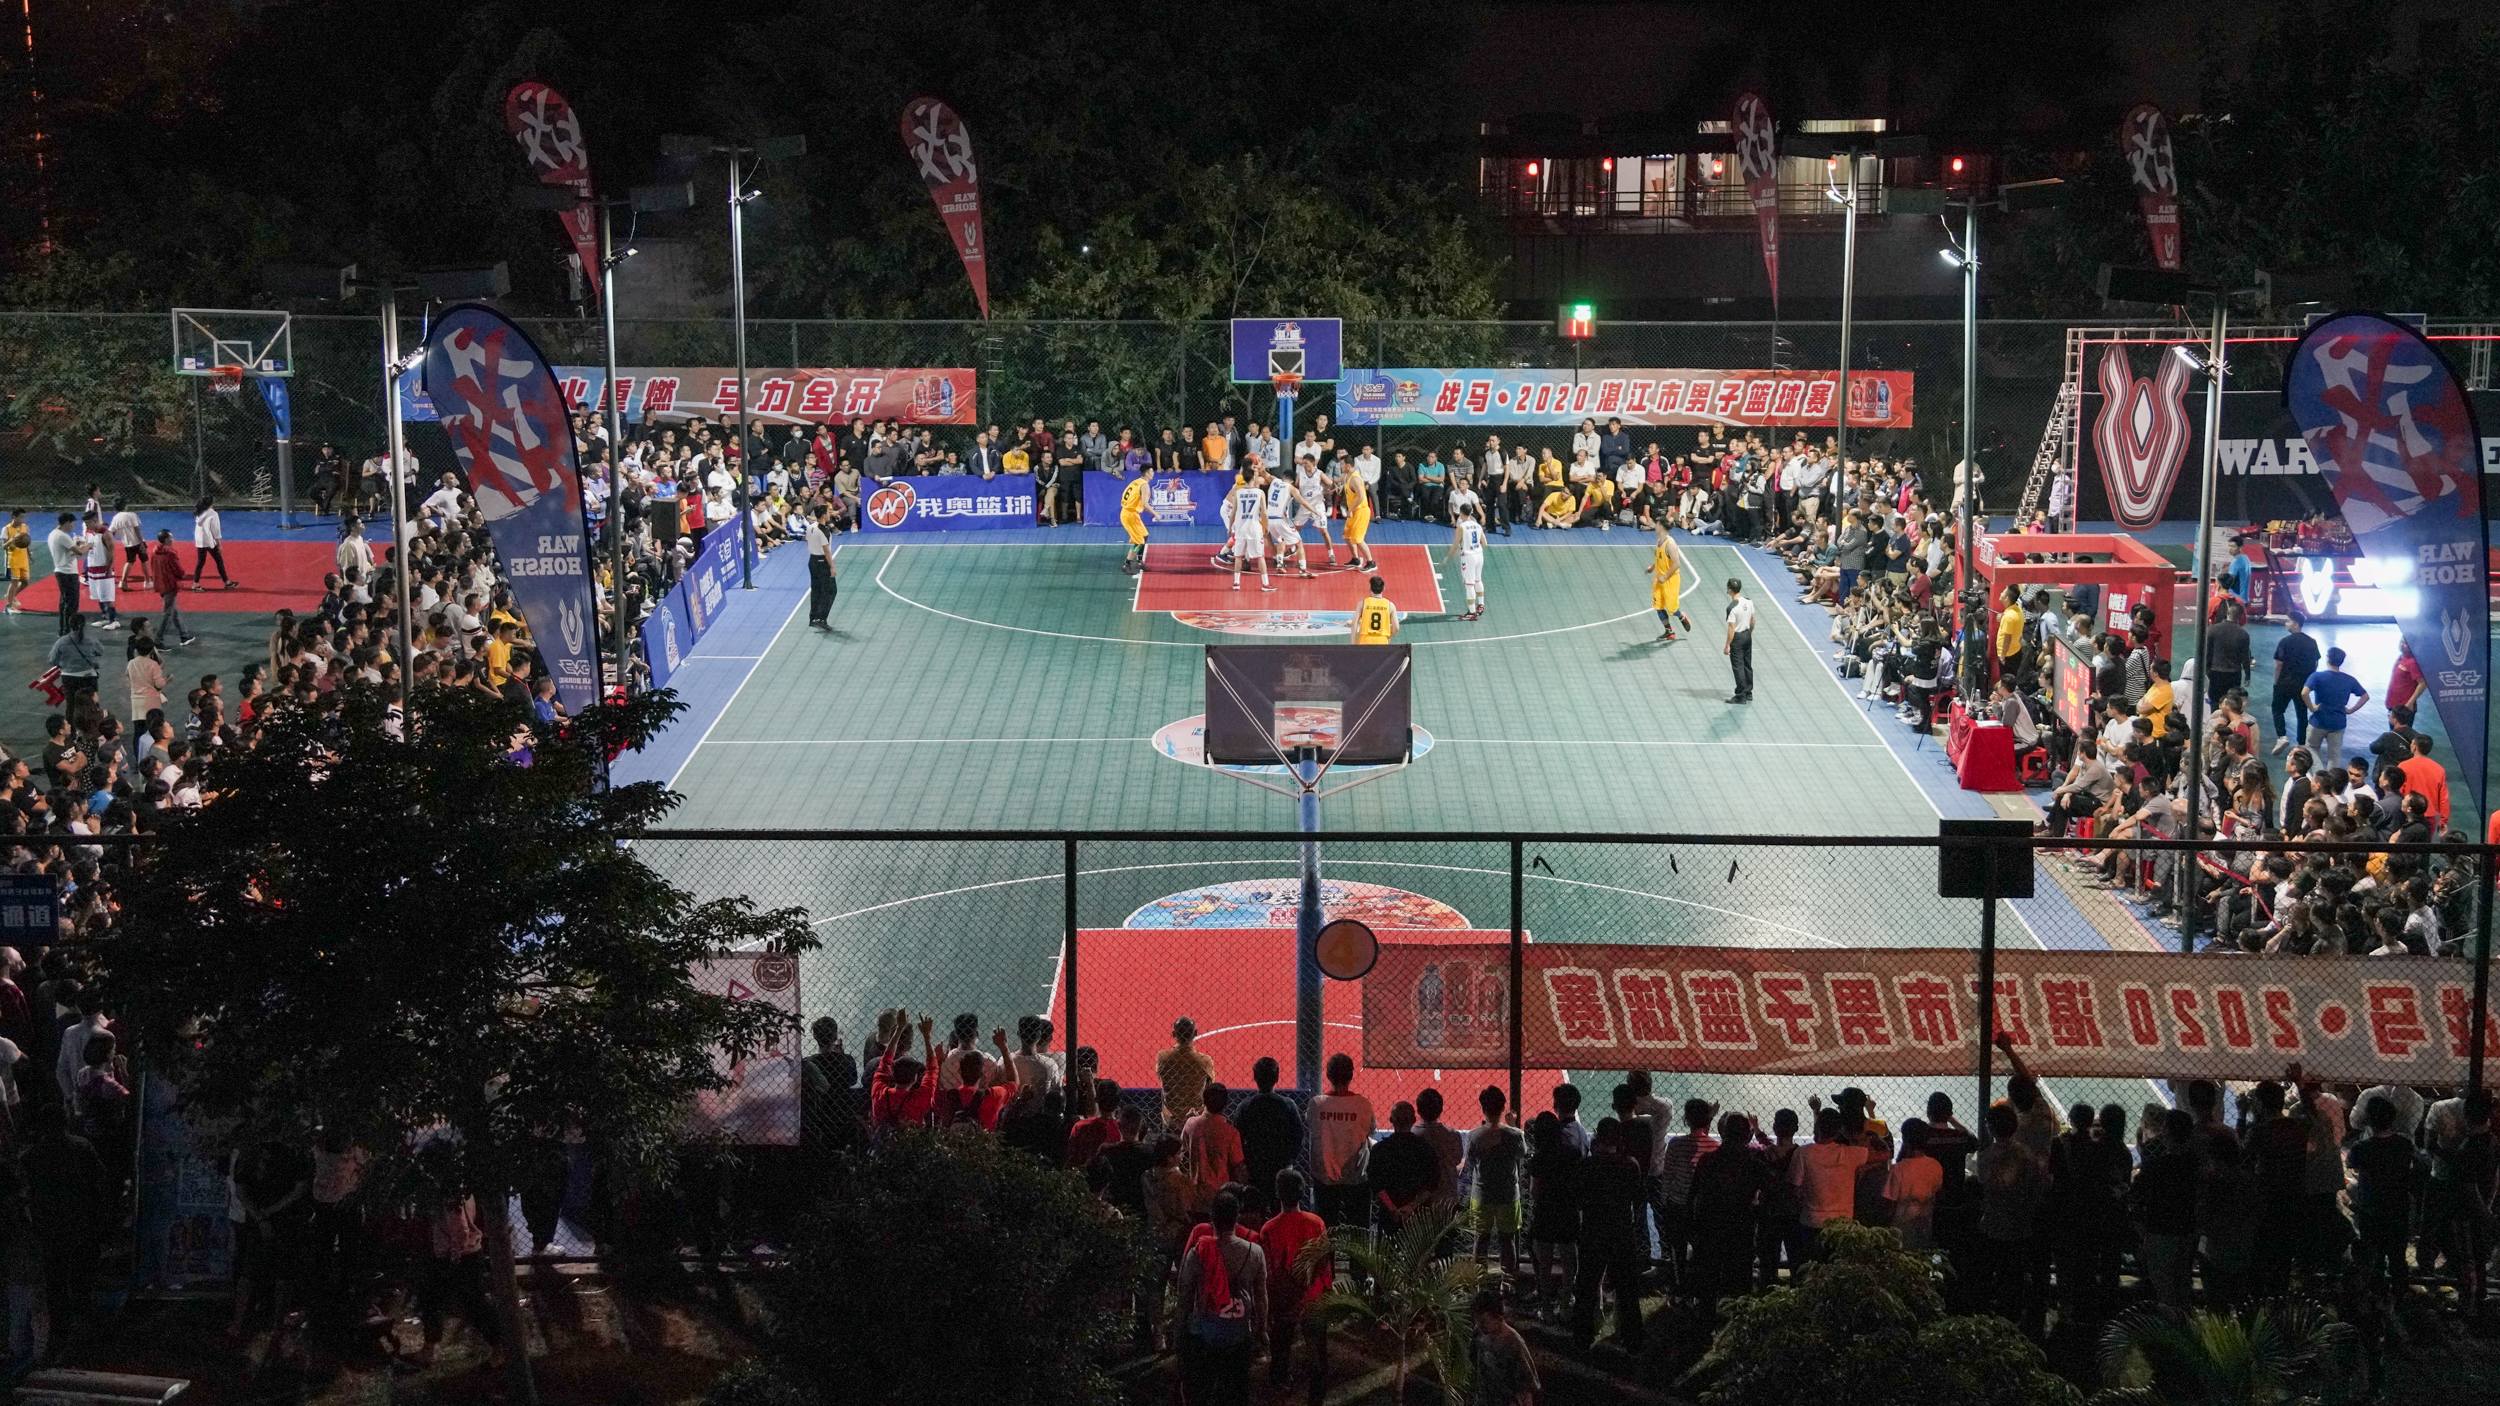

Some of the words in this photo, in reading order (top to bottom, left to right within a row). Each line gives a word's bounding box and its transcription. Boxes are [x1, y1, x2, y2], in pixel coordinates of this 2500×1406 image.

[714, 378, 884, 414] 马力全开
[917, 495, 1032, 517] 我奥篮球
[1241, 499, 1256, 514] 17
[1371, 612, 1381, 631] 8
[1219, 1298, 1245, 1318] 23
